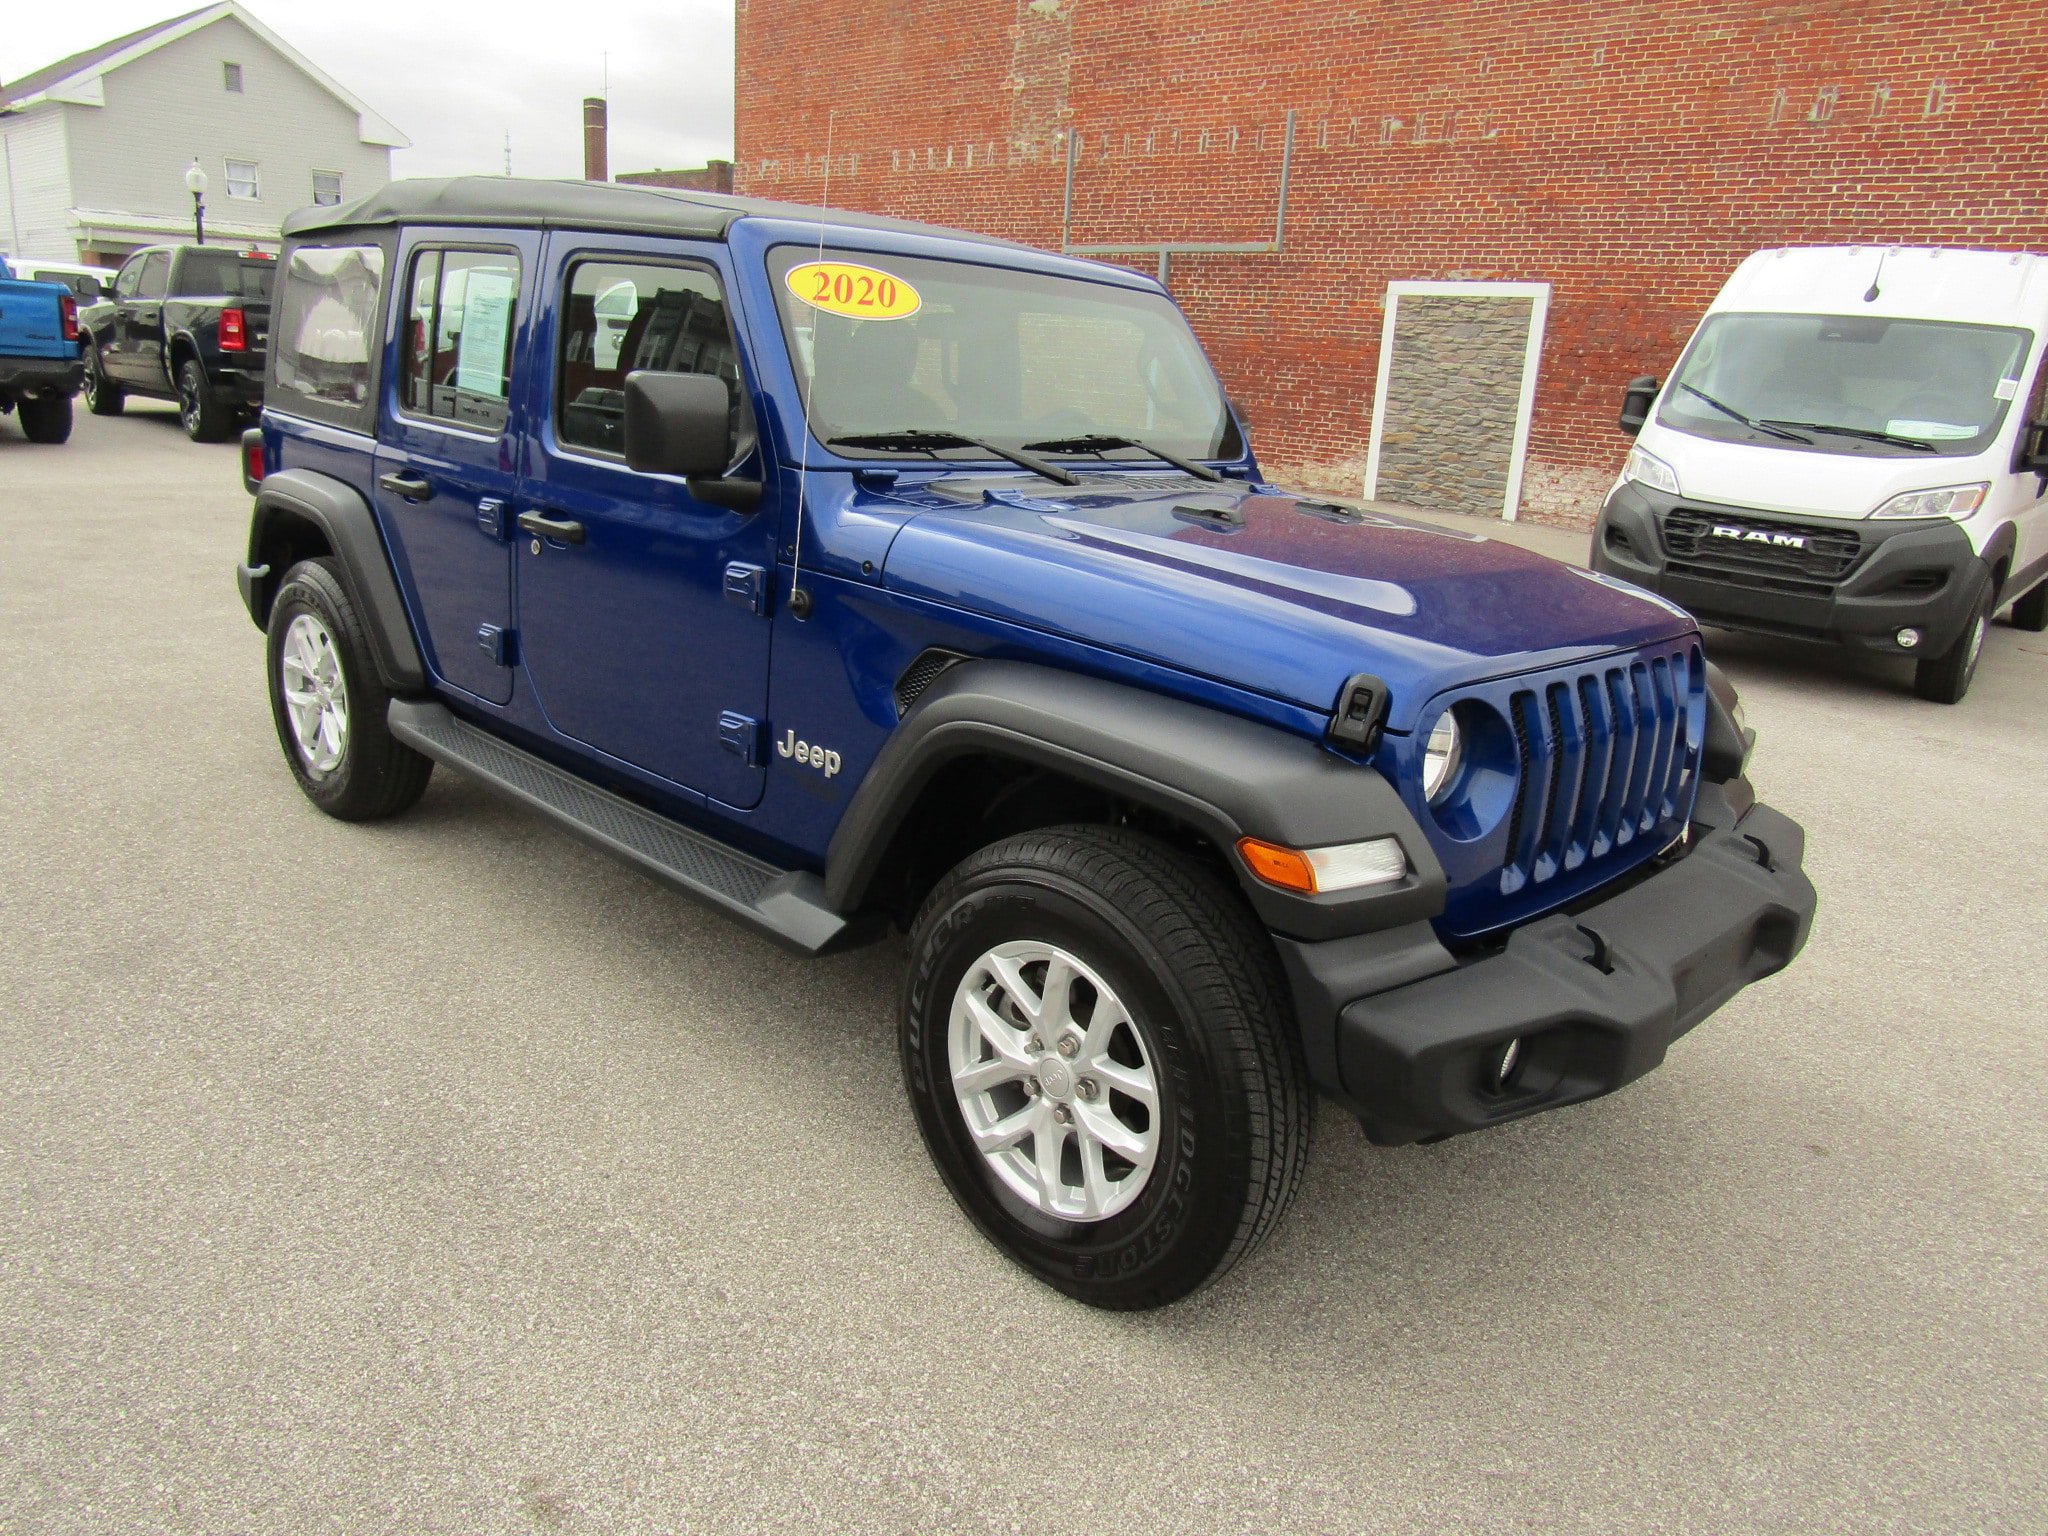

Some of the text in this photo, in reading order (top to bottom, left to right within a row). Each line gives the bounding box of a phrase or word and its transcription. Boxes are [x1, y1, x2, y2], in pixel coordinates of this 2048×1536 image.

[812, 271, 896, 308] 2020
[1713, 526, 1804, 548] RAM
[777, 729, 842, 779] Jeep
[1044, 1069, 1063, 1087] Jeep
